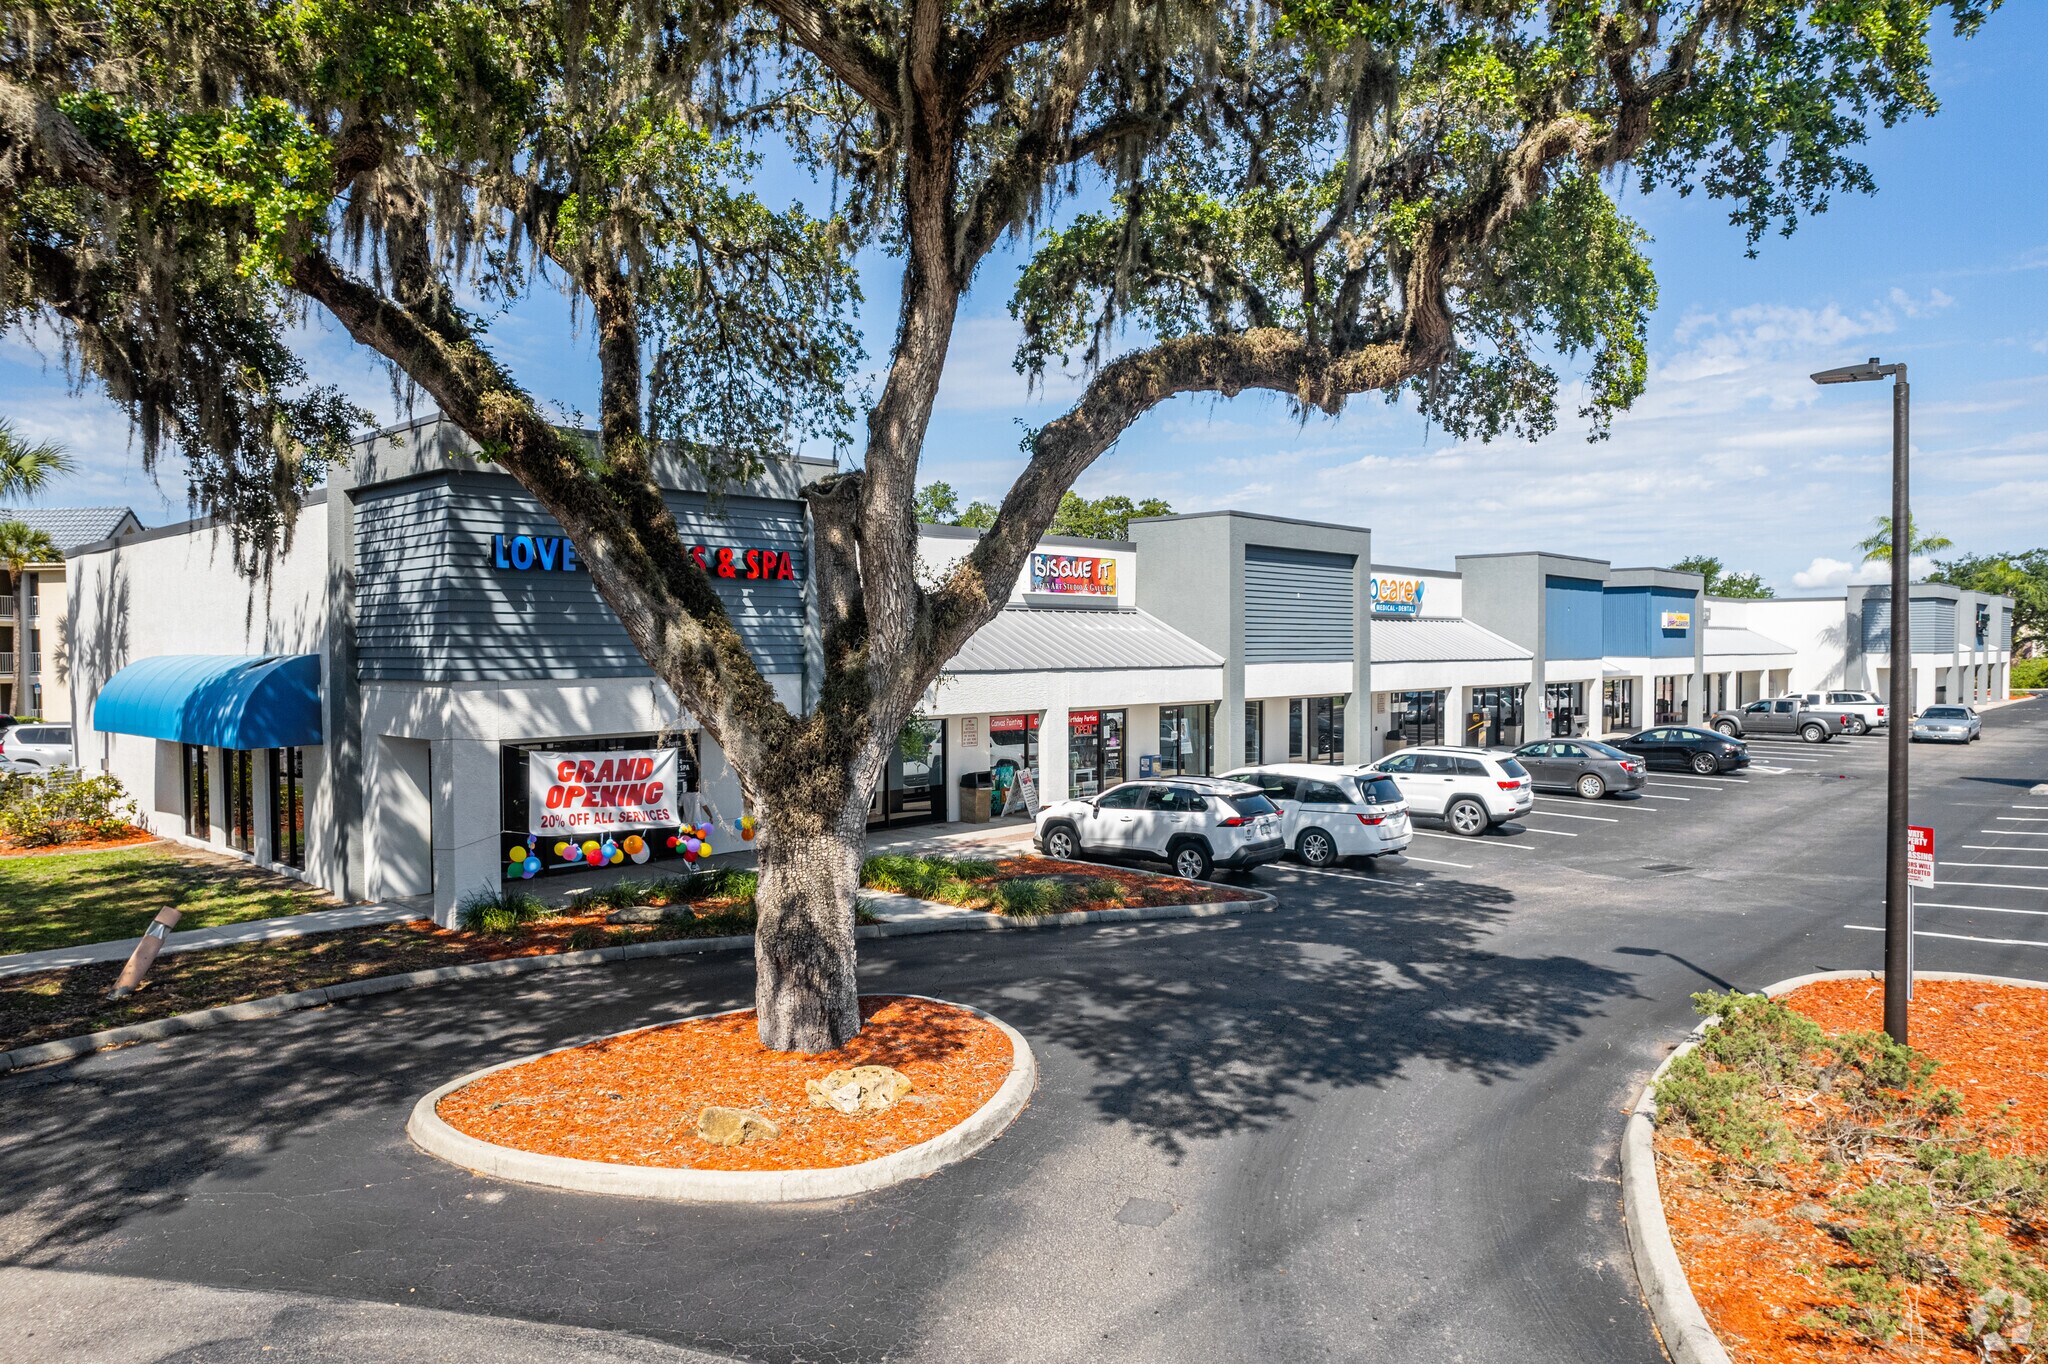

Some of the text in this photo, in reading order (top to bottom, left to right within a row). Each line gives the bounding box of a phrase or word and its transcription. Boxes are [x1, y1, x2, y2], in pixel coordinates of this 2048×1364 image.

[494, 534, 577, 571] LOVE
[717, 547, 737, 578] &
[746, 549, 794, 580] SPA
[1034, 556, 1113, 580] BISQUE IT
[1063, 582, 1082, 592] STUDIO
[1090, 583, 1114, 593] GALLERY
[991, 718, 1023, 727] Canvas Painting
[1068, 716, 1084, 724] irthday
[1074, 724, 1092, 735] OPEN
[557, 757, 654, 784] GRAND
[545, 781, 664, 809] OPENING
[540, 808, 670, 828] 20% OFF ALL SERVICES
[1908, 830, 1925, 839] VATE
[1908, 837, 1928, 846] PERTY
[1908, 851, 1933, 861] ASSING
[1918, 862, 1931, 870] WILL
[1908, 868, 1931, 877] SECUTED
